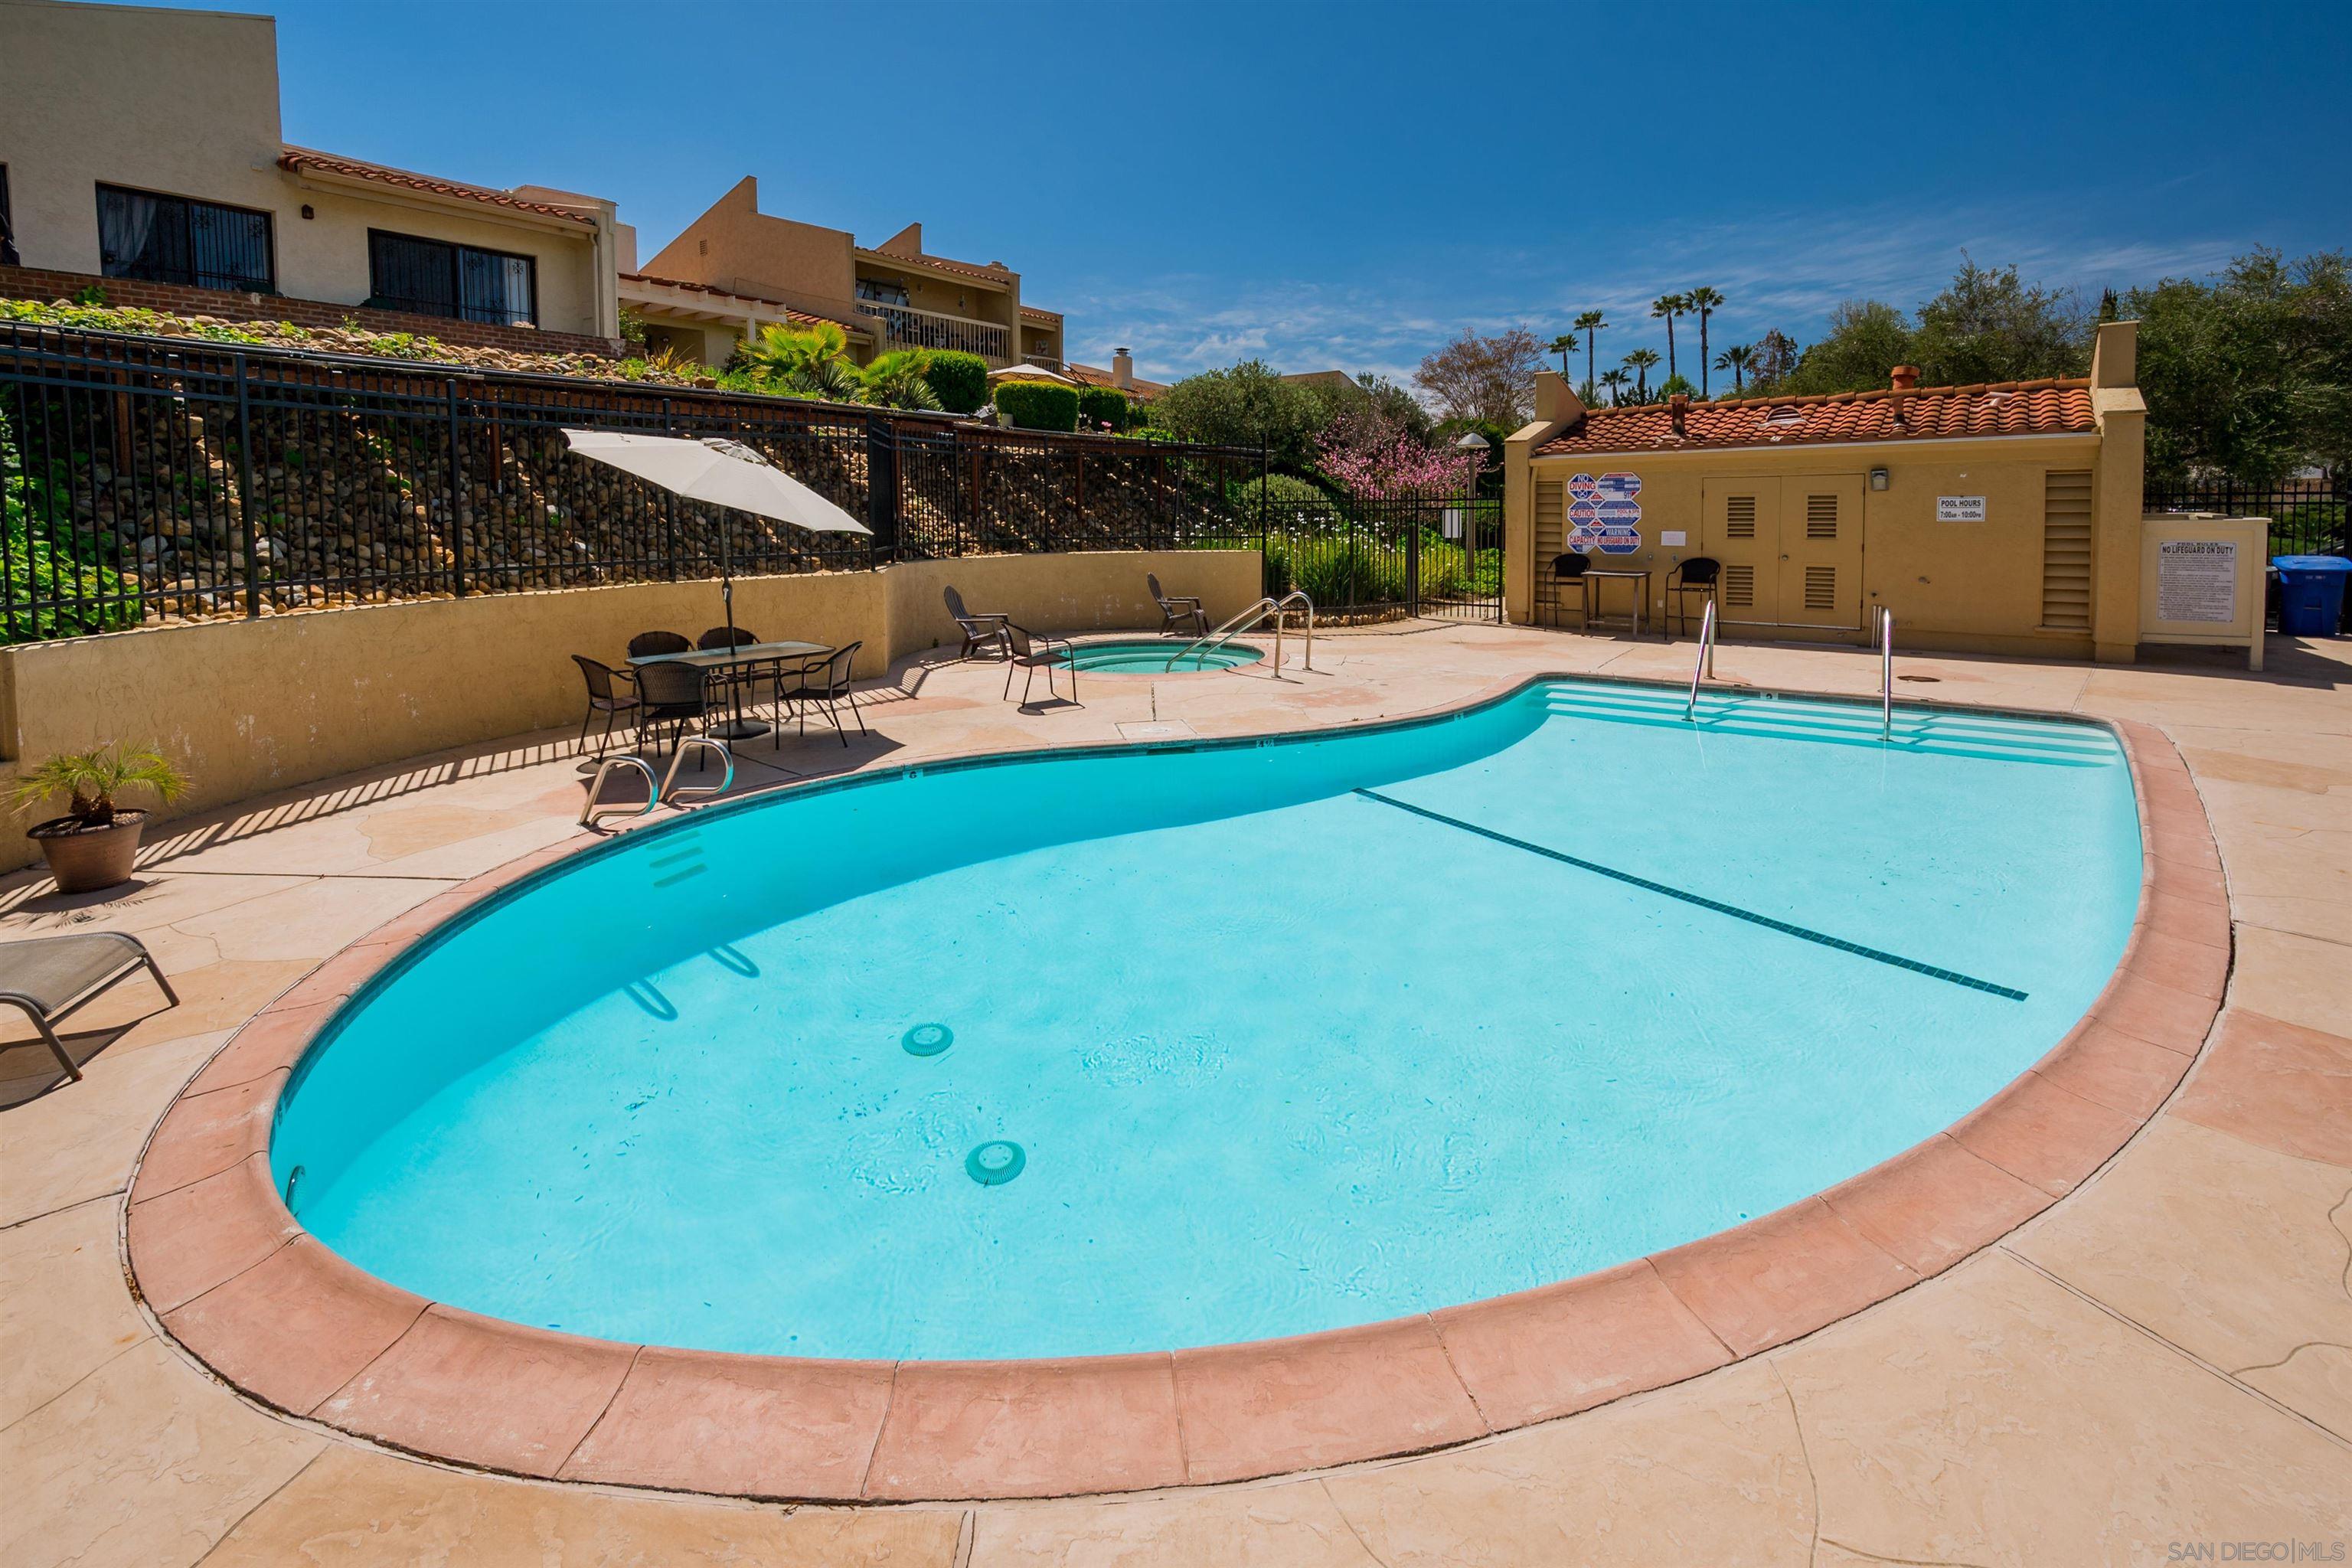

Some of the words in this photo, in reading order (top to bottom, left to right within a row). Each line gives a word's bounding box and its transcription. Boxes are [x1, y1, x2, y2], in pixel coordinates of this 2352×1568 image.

[1577, 474, 1589, 482] NO
[1569, 509, 1596, 518] CAUTION
[1569, 535, 1596, 544] CAPACITY
[2172, 546, 2205, 554] LIFEGUARD
[2207, 546, 2215, 554] ON
[2216, 546, 2234, 554] DUTY
